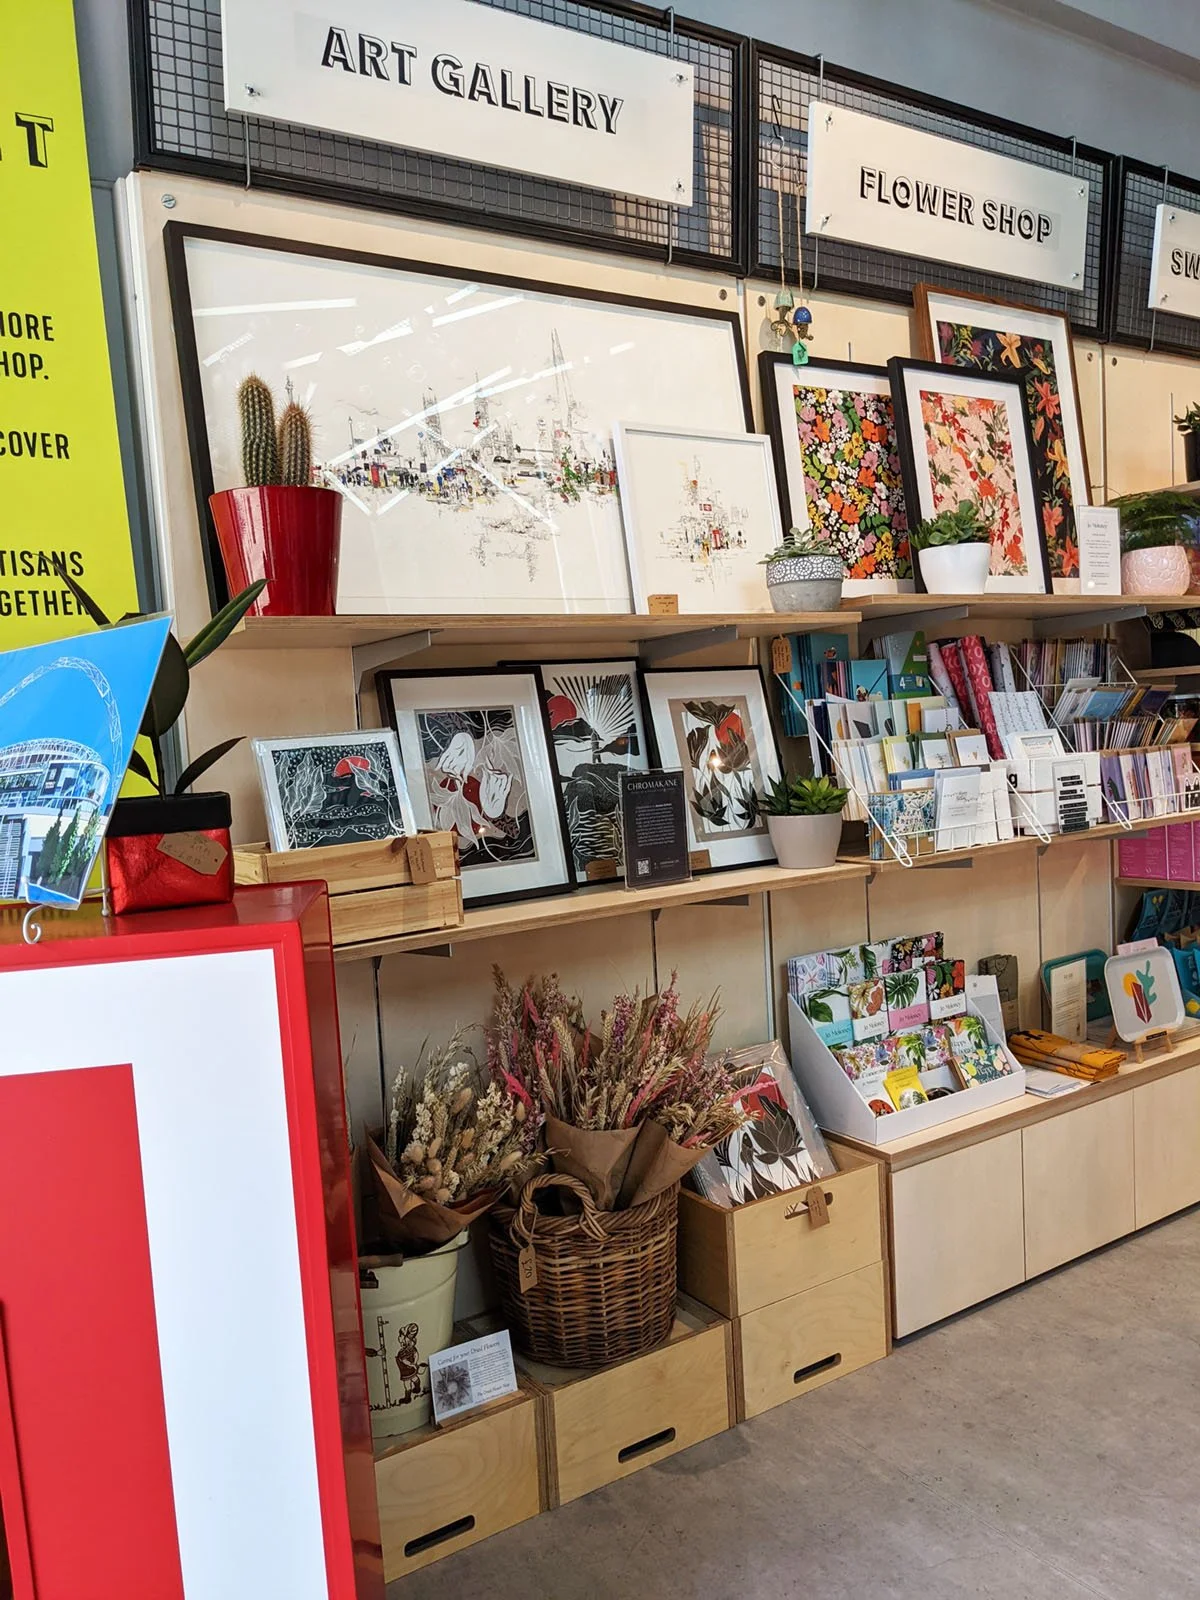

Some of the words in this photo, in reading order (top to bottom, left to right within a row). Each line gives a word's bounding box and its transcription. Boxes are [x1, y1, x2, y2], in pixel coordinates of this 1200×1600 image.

[321, 26, 417, 87] ART
[430, 53, 624, 135] GALLERY
[0, 112, 54, 168] T
[860, 166, 975, 226] FLOWER
[982, 199, 1053, 243] SHOP
